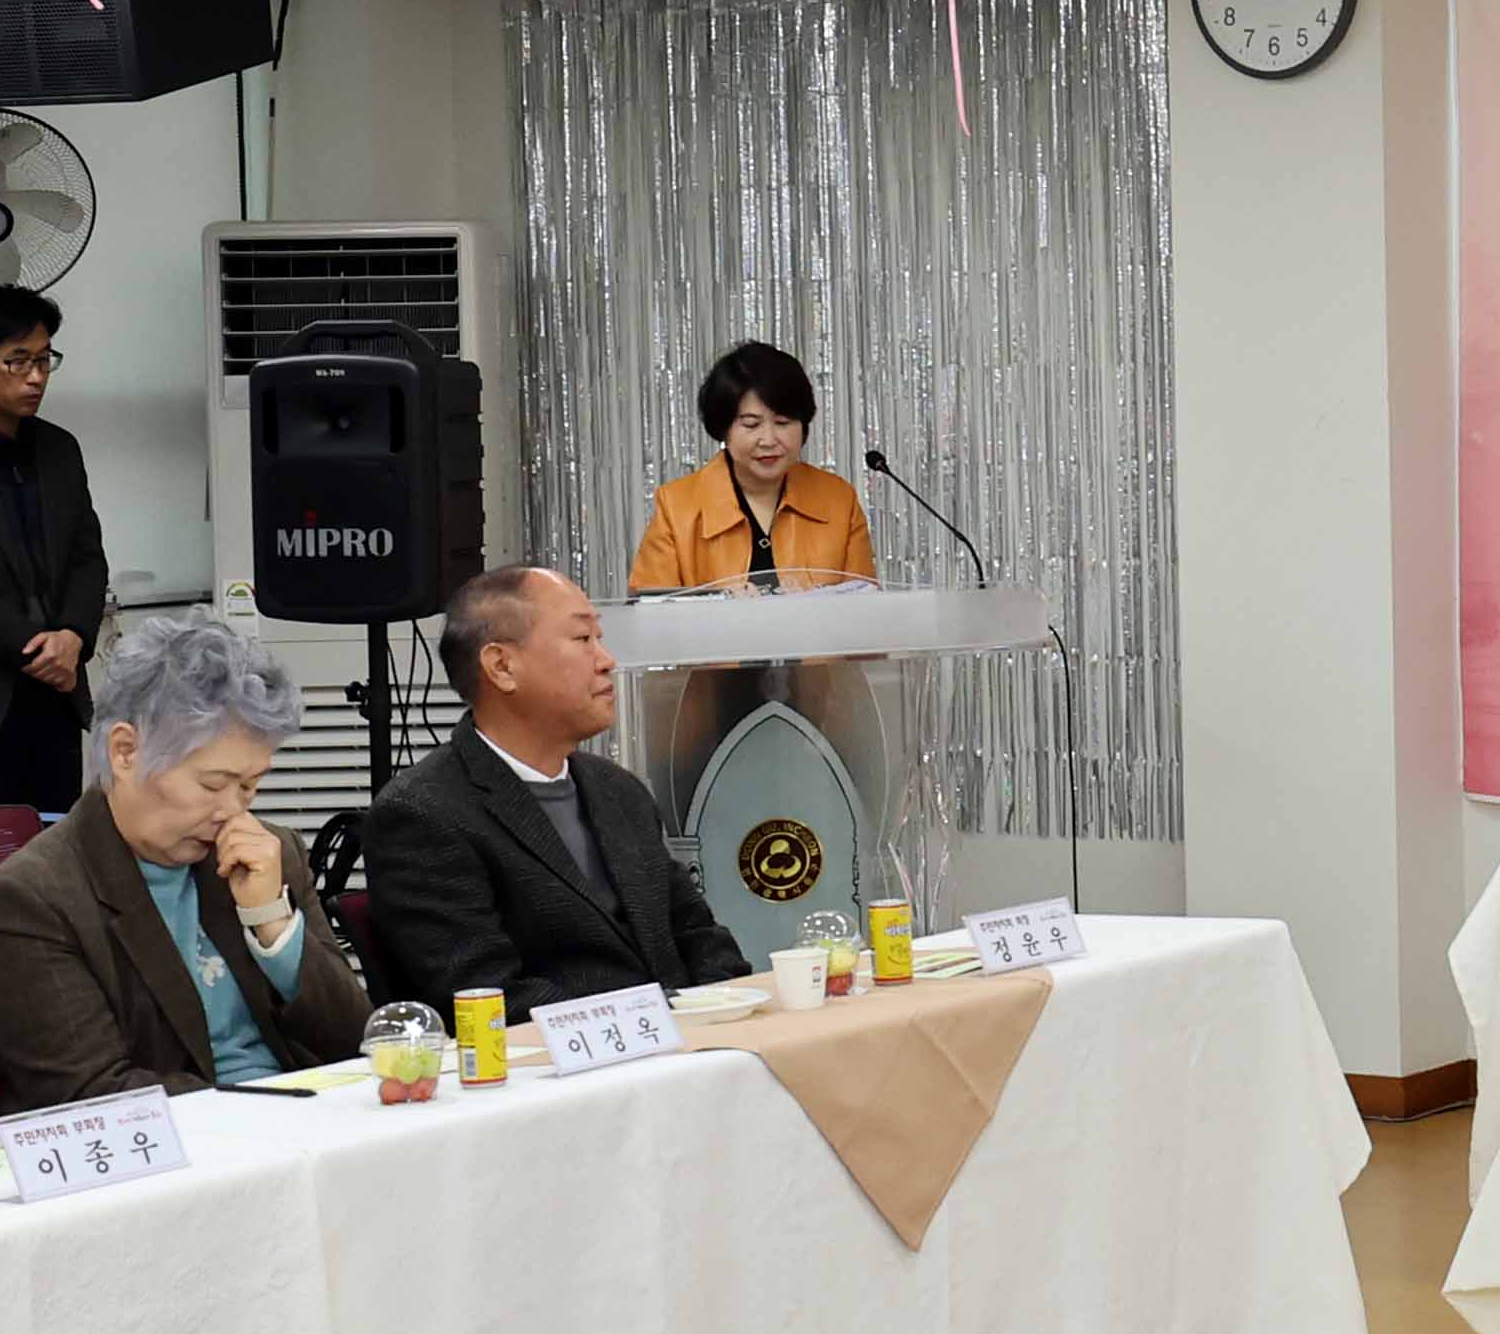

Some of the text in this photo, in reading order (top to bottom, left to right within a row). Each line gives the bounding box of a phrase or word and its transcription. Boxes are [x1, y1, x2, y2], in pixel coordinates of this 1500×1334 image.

[1224, 7, 1235, 26] 8
[1316, 8, 1326, 26] 4
[1244, 29, 1254, 48] 7
[1269, 37, 1280, 56] 6
[1297, 28, 1308, 46] 5
[277, 512, 393, 557] MIPRO
[38, 1132, 159, 1183] 이종우
